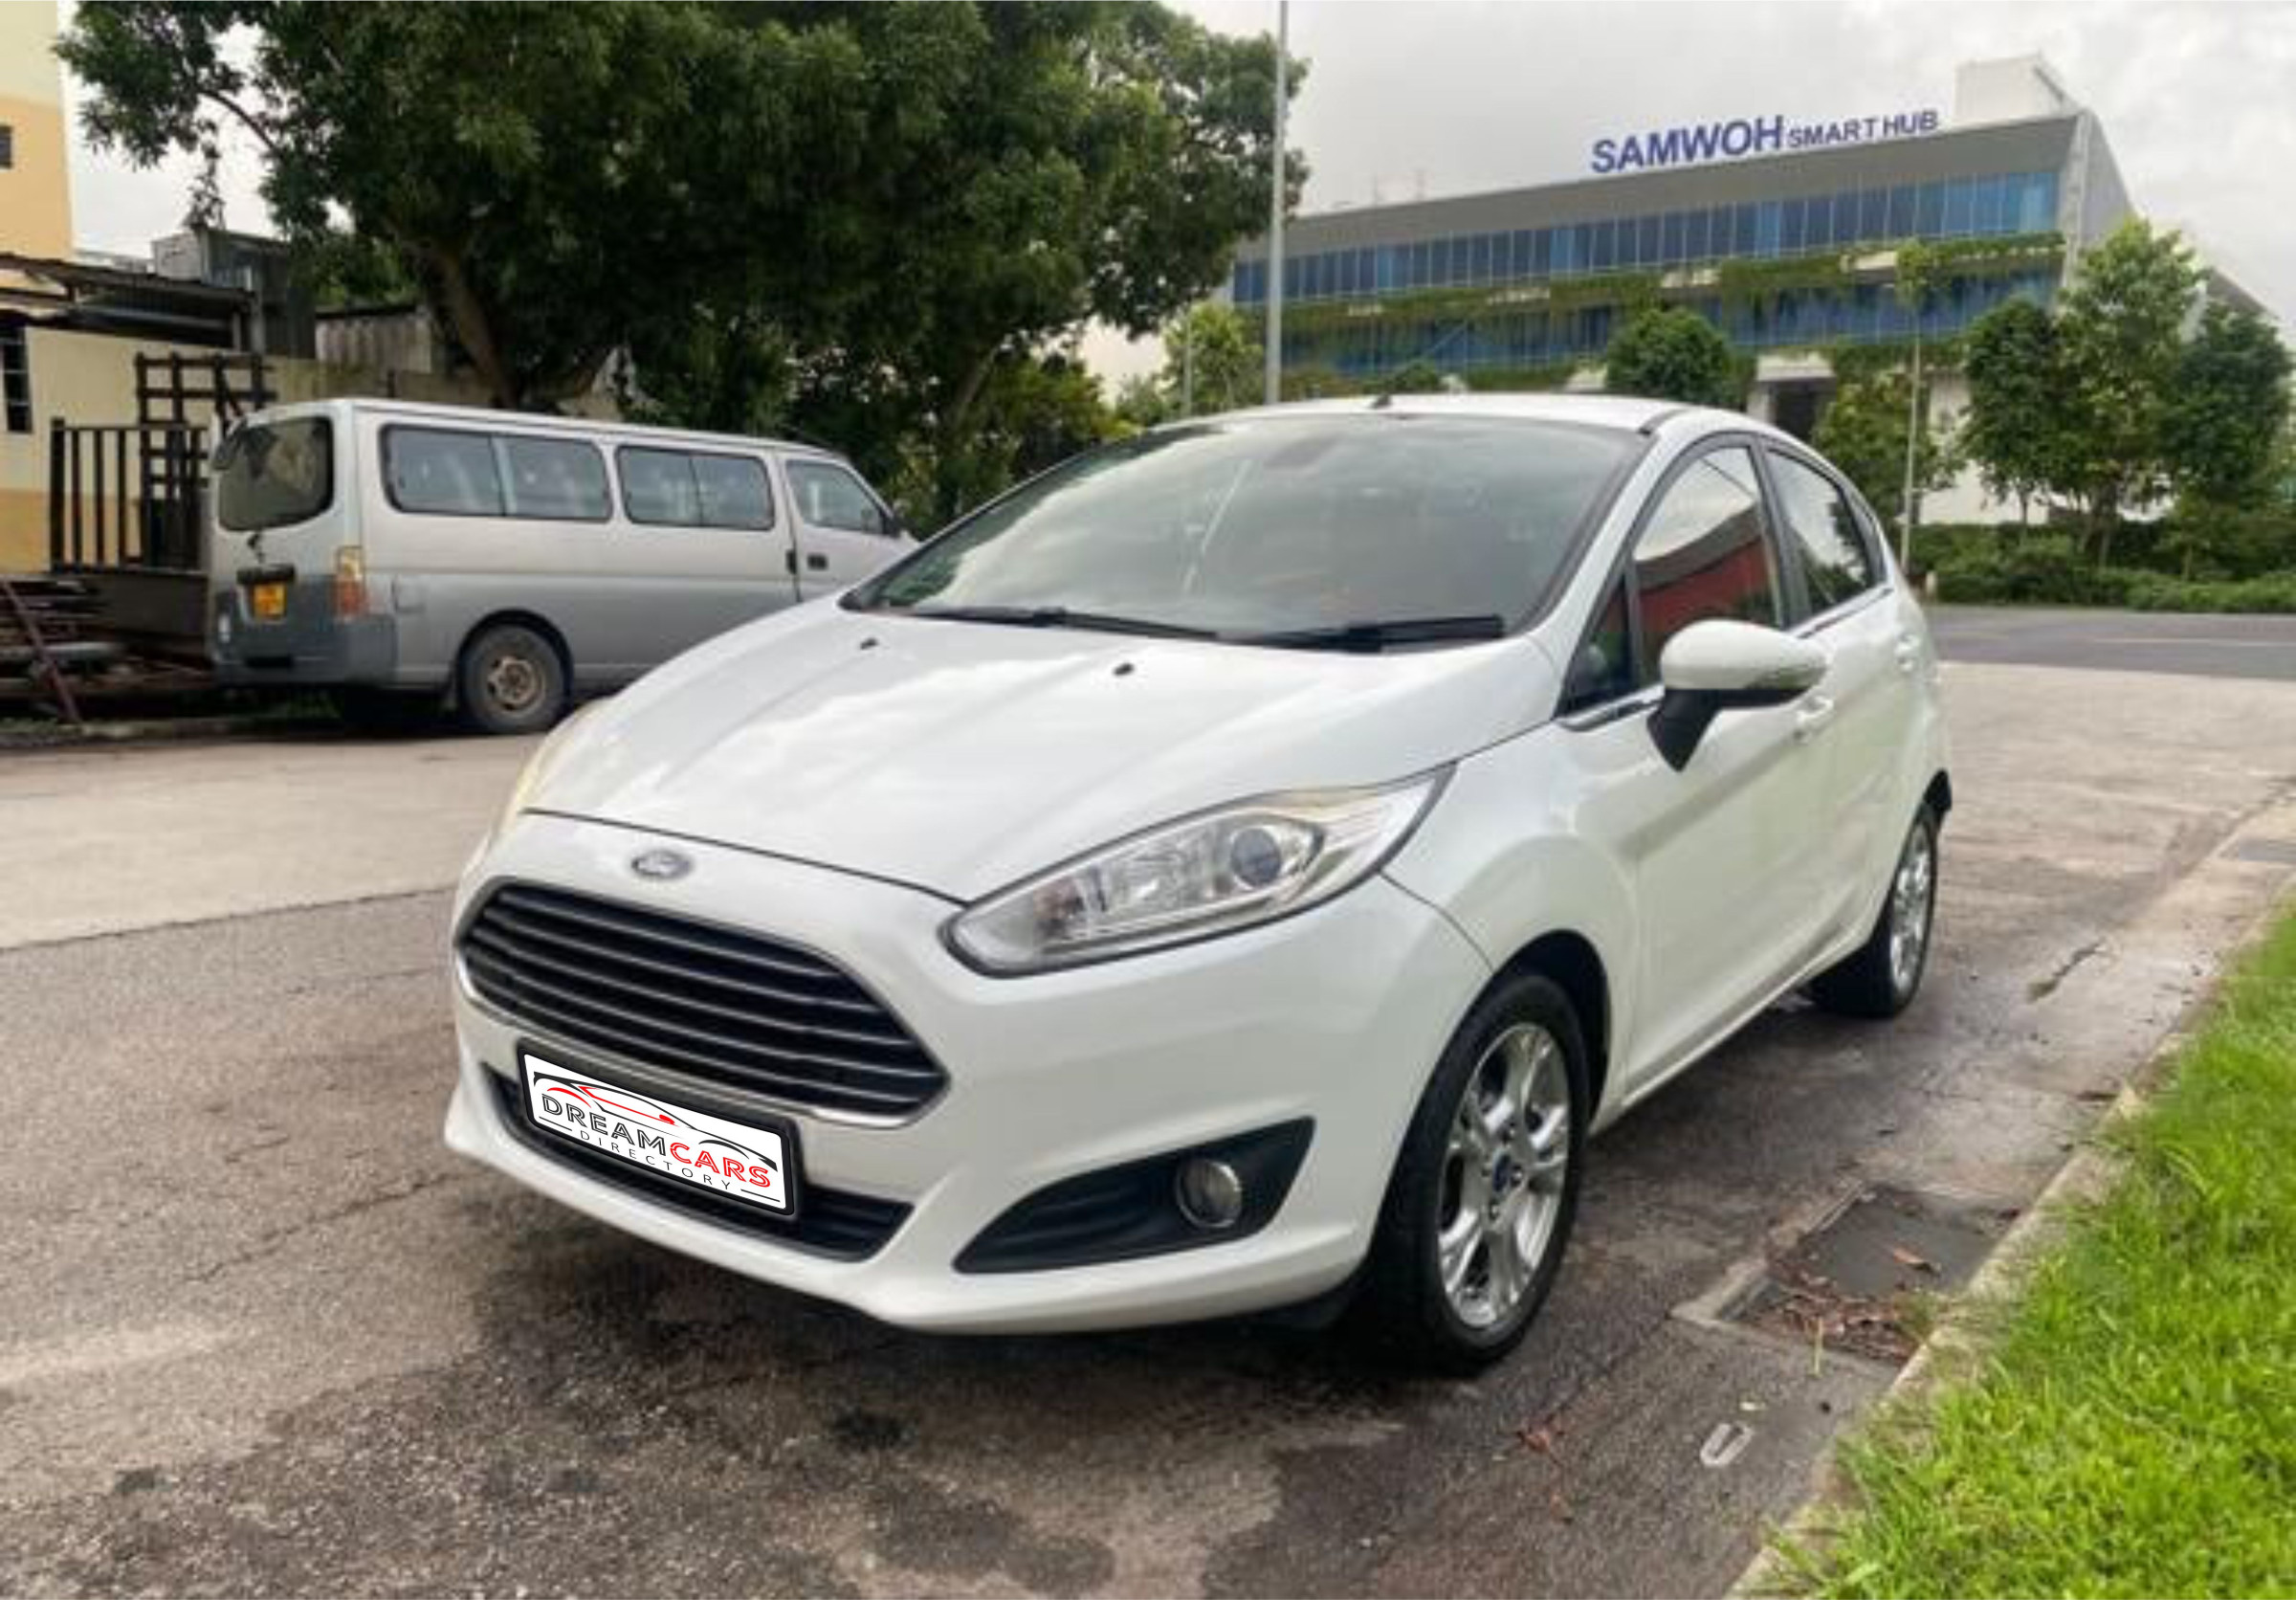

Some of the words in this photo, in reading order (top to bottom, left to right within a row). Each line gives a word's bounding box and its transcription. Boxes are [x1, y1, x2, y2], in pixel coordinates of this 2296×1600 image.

[1591, 115, 1784, 173] SAMWOH
[1786, 117, 1878, 148] SMART
[1883, 109, 1938, 138] HUB
